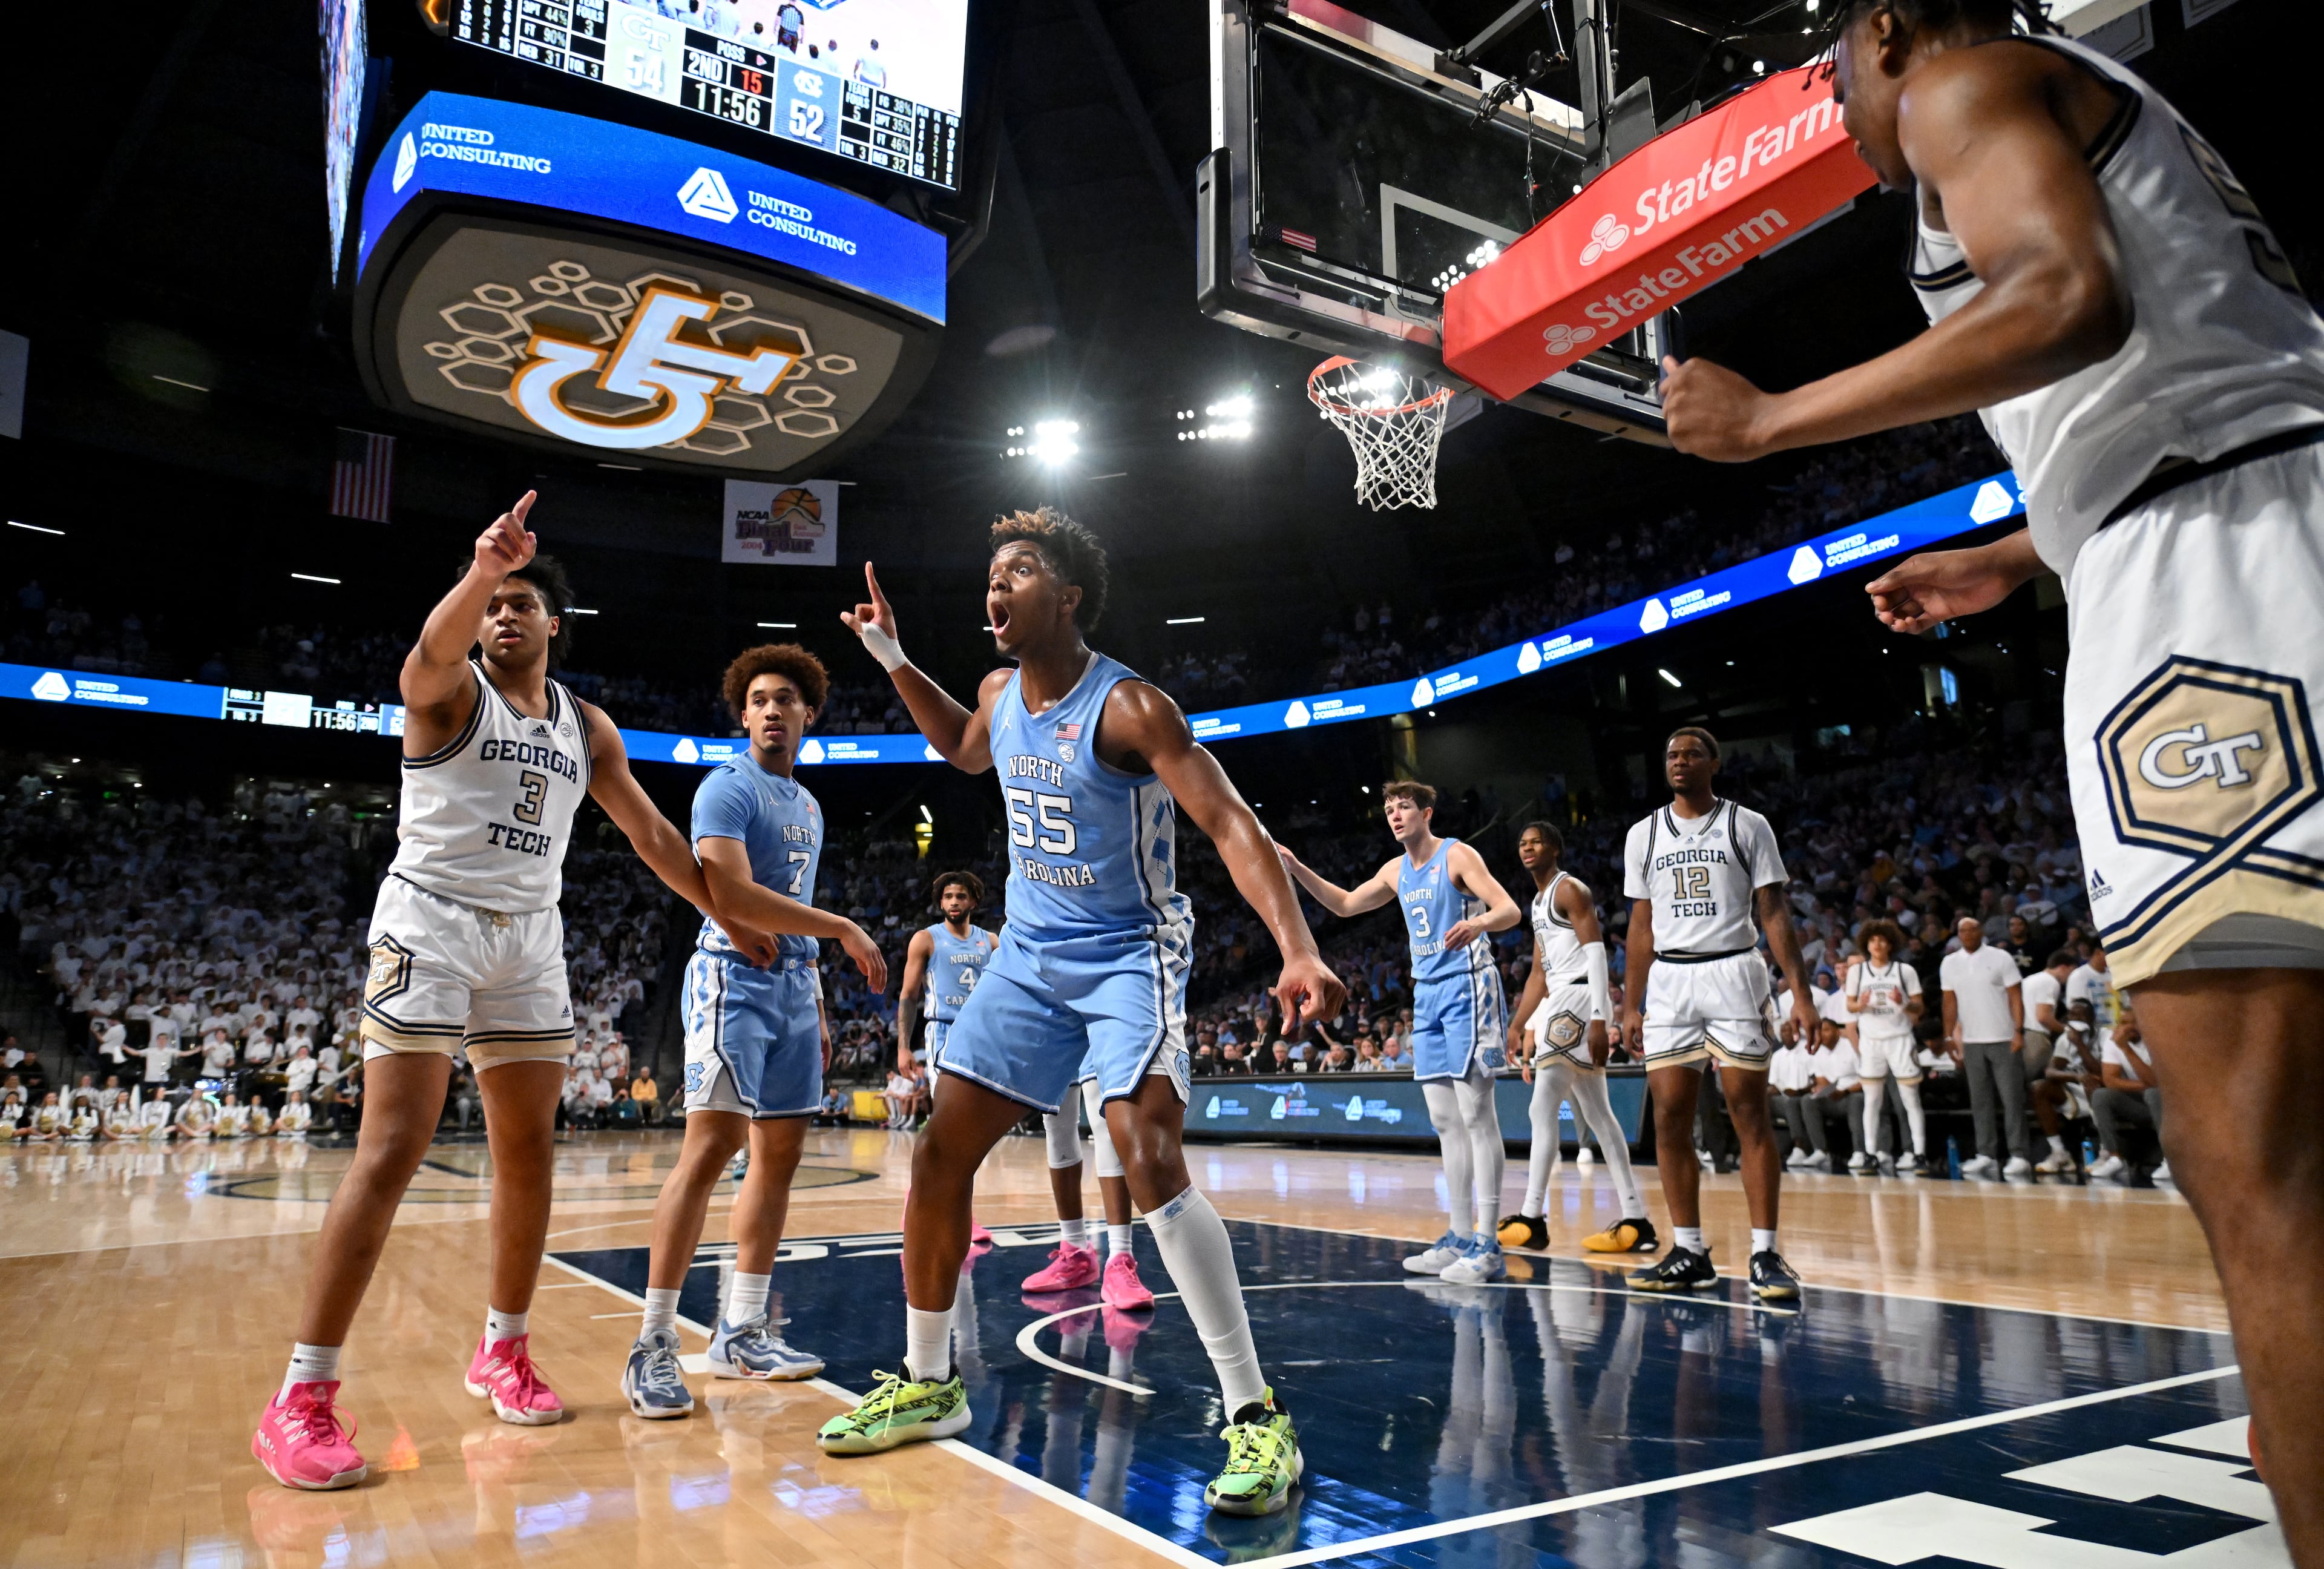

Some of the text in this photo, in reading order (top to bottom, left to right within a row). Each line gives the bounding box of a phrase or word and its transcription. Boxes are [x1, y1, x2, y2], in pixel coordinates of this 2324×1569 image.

[522, 0, 568, 26] 3PT 44%
[576, 4, 604, 24] FOULS
[524, 22, 565, 47] FT 90%
[584, 19, 594, 36] 3
[499, 36, 511, 51] 15
[717, 40, 745, 62] POSS
[519, 43, 560, 67] REB 31
[569, 58, 599, 78] TOL 3
[625, 47, 664, 93] 54
[688, 51, 763, 94] 2ND 15
[848, 81, 870, 97] TEAM
[695, 83, 761, 127] 11:56
[846, 91, 870, 110] FOULS
[879, 94, 911, 117] FG 38%
[789, 99, 824, 143] 52
[853, 105, 861, 121] 5
[875, 113, 911, 135] 3PT 35%
[919, 117, 925, 130] 3
[422, 123, 494, 145] UNITED
[876, 133, 910, 154] FT 46%
[918, 130, 924, 142] 4
[420, 142, 551, 174] CONSULTING
[841, 140, 866, 160] TOL 3
[872, 151, 905, 173] REB 32
[748, 191, 812, 222] UNITED
[747, 210, 857, 256] CONSULTING
[737, 510, 769, 519] NCAA
[736, 521, 790, 539] Final
[764, 538, 815, 556] Four
[1825, 533, 1866, 555] UNITED
[1827, 535, 1899, 567] CONSULTING
[1670, 589, 1704, 608] UNITED
[1672, 591, 1731, 619] CONSULTING
[1543, 634, 1571, 651] UNITED
[314, 711, 357, 731] 11:56
[361, 717, 378, 730] 2ND
[702, 745, 733, 754] UNITED
[828, 743, 858, 751] UNITED
[828, 750, 879, 759] CONSULTING
[480, 739, 577, 784] GEORGIA
[1008, 755, 1063, 788] NORTH
[513, 769, 548, 826] 3
[1006, 786, 1076, 855] 55
[488, 822, 551, 857] TECH
[782, 824, 818, 848] NORTH
[1656, 849, 1728, 870] GEORGIA
[788, 850, 811, 895] 7
[1673, 866, 1710, 900] 12
[1404, 887, 1433, 904] NORTH
[1671, 902, 1717, 918] TECH
[1411, 906, 1431, 938] 3
[950, 954, 981, 965] NORTH
[958, 967, 976, 992] 4
